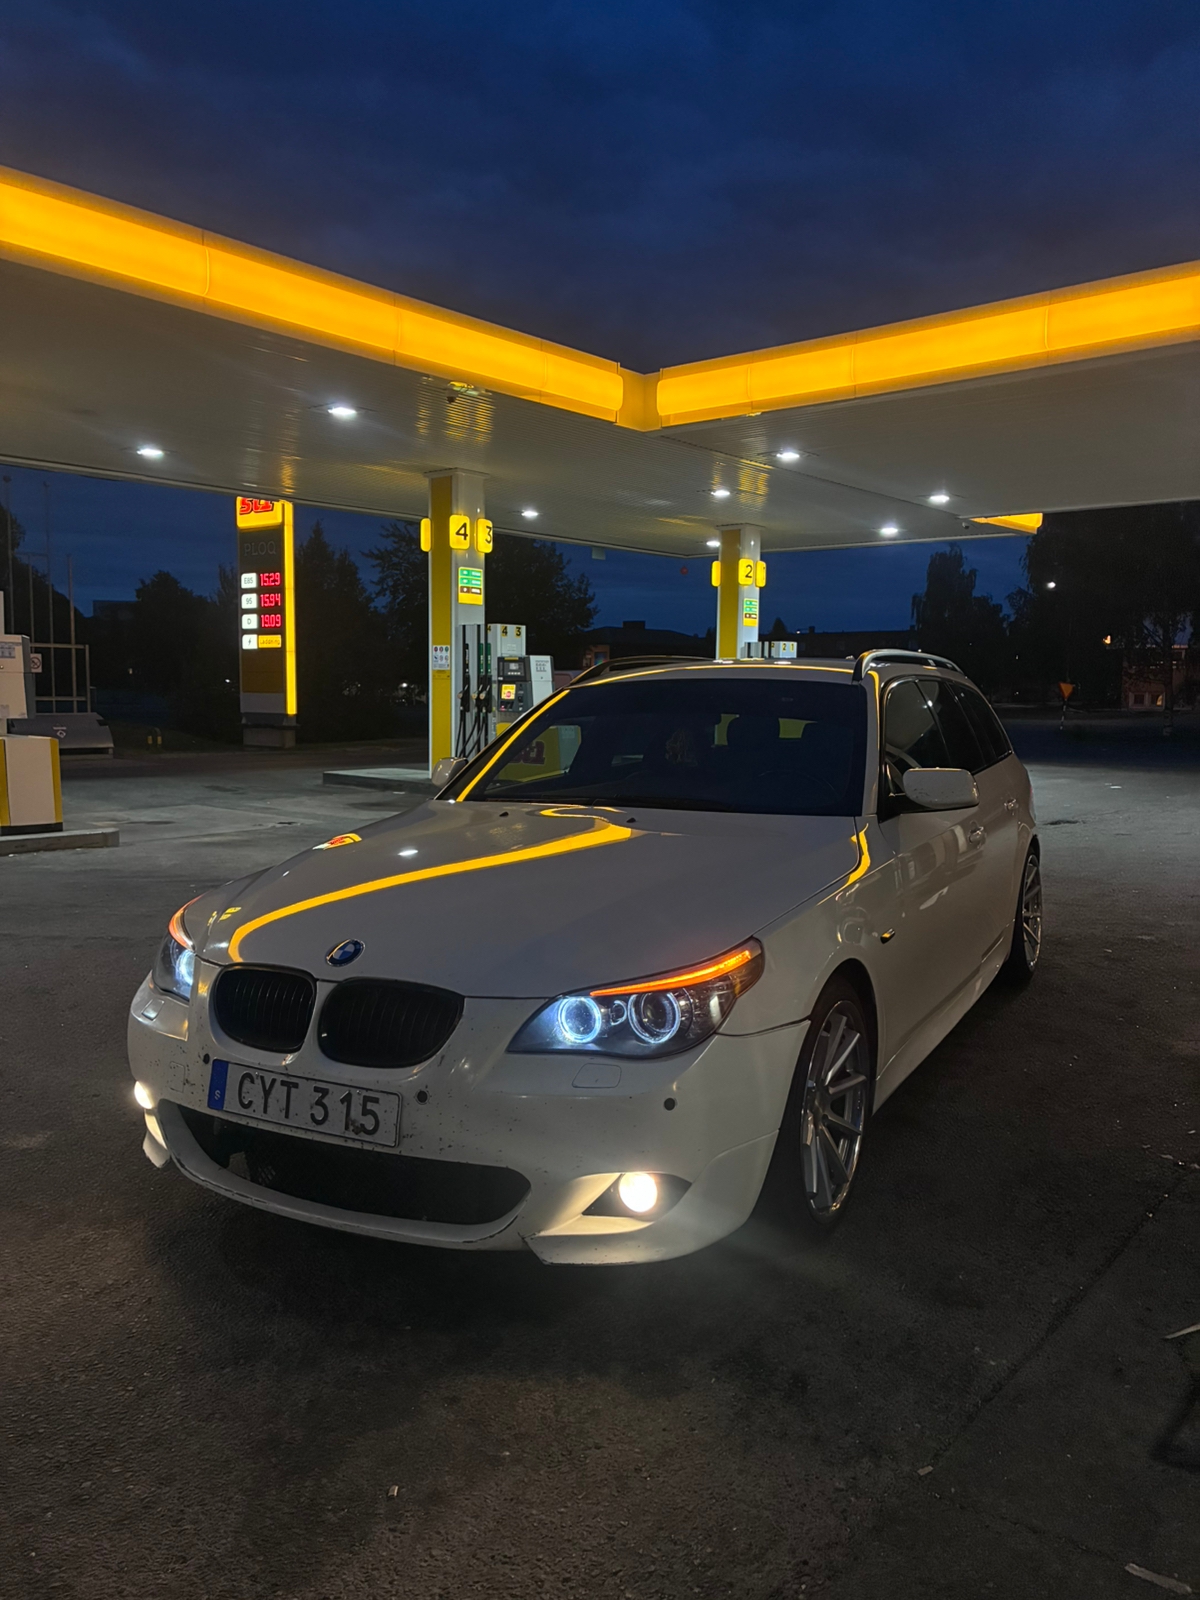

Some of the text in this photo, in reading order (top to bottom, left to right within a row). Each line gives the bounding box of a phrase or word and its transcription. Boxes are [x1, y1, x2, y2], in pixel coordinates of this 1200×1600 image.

[455, 523, 468, 541] 4
[485, 525, 493, 544] 3
[745, 564, 753, 578] 2
[243, 576, 254, 585] E85
[245, 597, 253, 605] 95
[501, 626, 508, 636] 4
[515, 626, 522, 637] 3
[782, 643, 787, 651] 2
[214, 1089, 221, 1100] S
[237, 1072, 380, 1136] CYT 315
